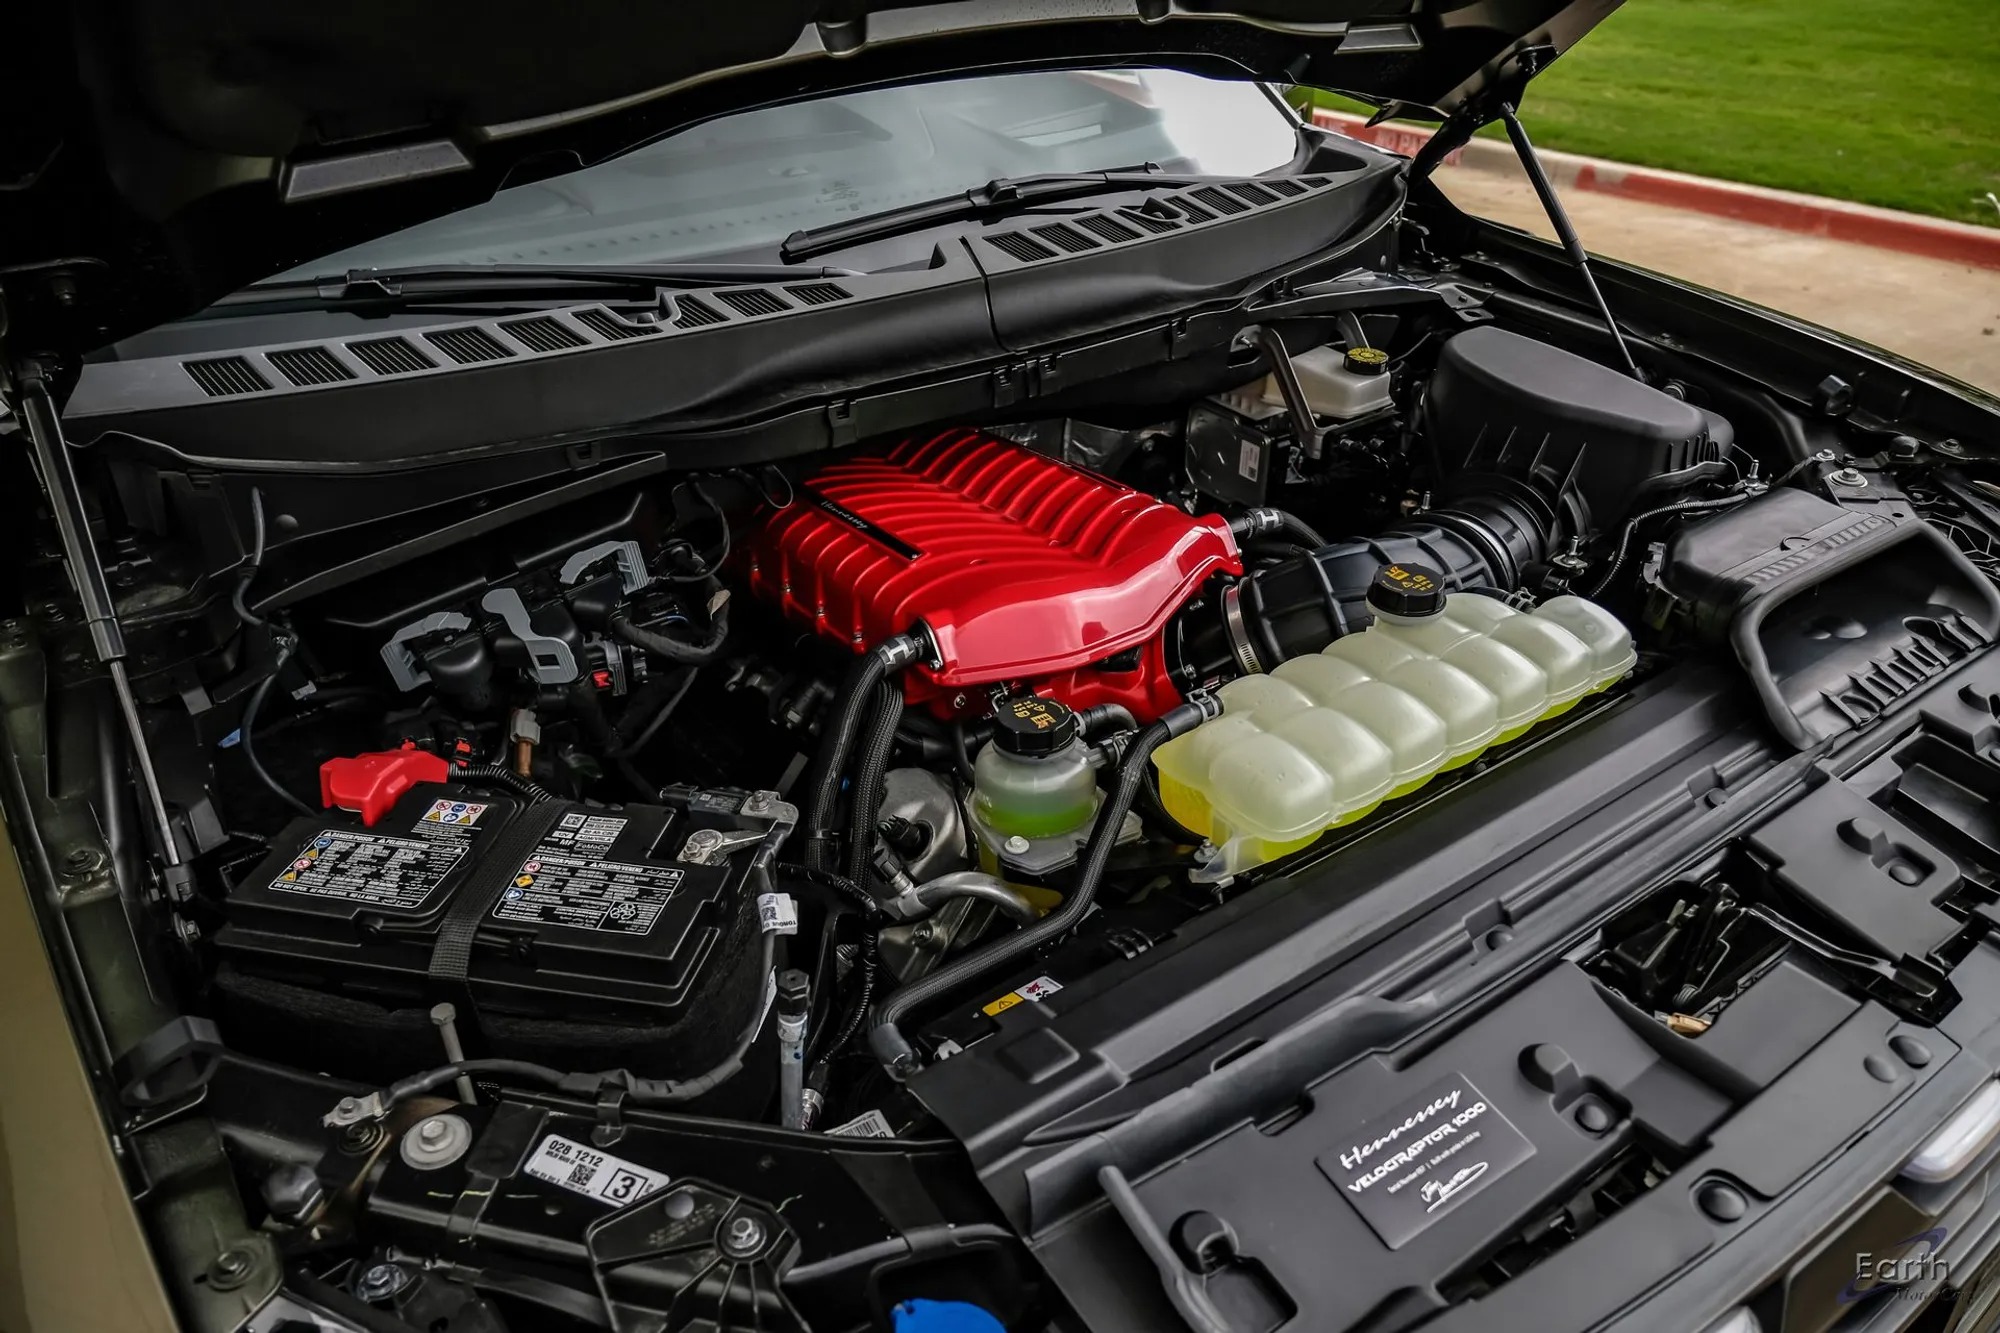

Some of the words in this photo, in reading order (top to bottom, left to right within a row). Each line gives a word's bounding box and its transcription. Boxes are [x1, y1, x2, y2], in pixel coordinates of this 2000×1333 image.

[549, 1139, 572, 1155] 028
[574, 1149, 604, 1168] 1212
[1340, 1090, 1461, 1169] Hennessey
[1348, 1123, 1458, 1193] VELOCIRAPTOR
[1452, 1102, 1487, 1127] 1000
[612, 1176, 636, 1199] 3
